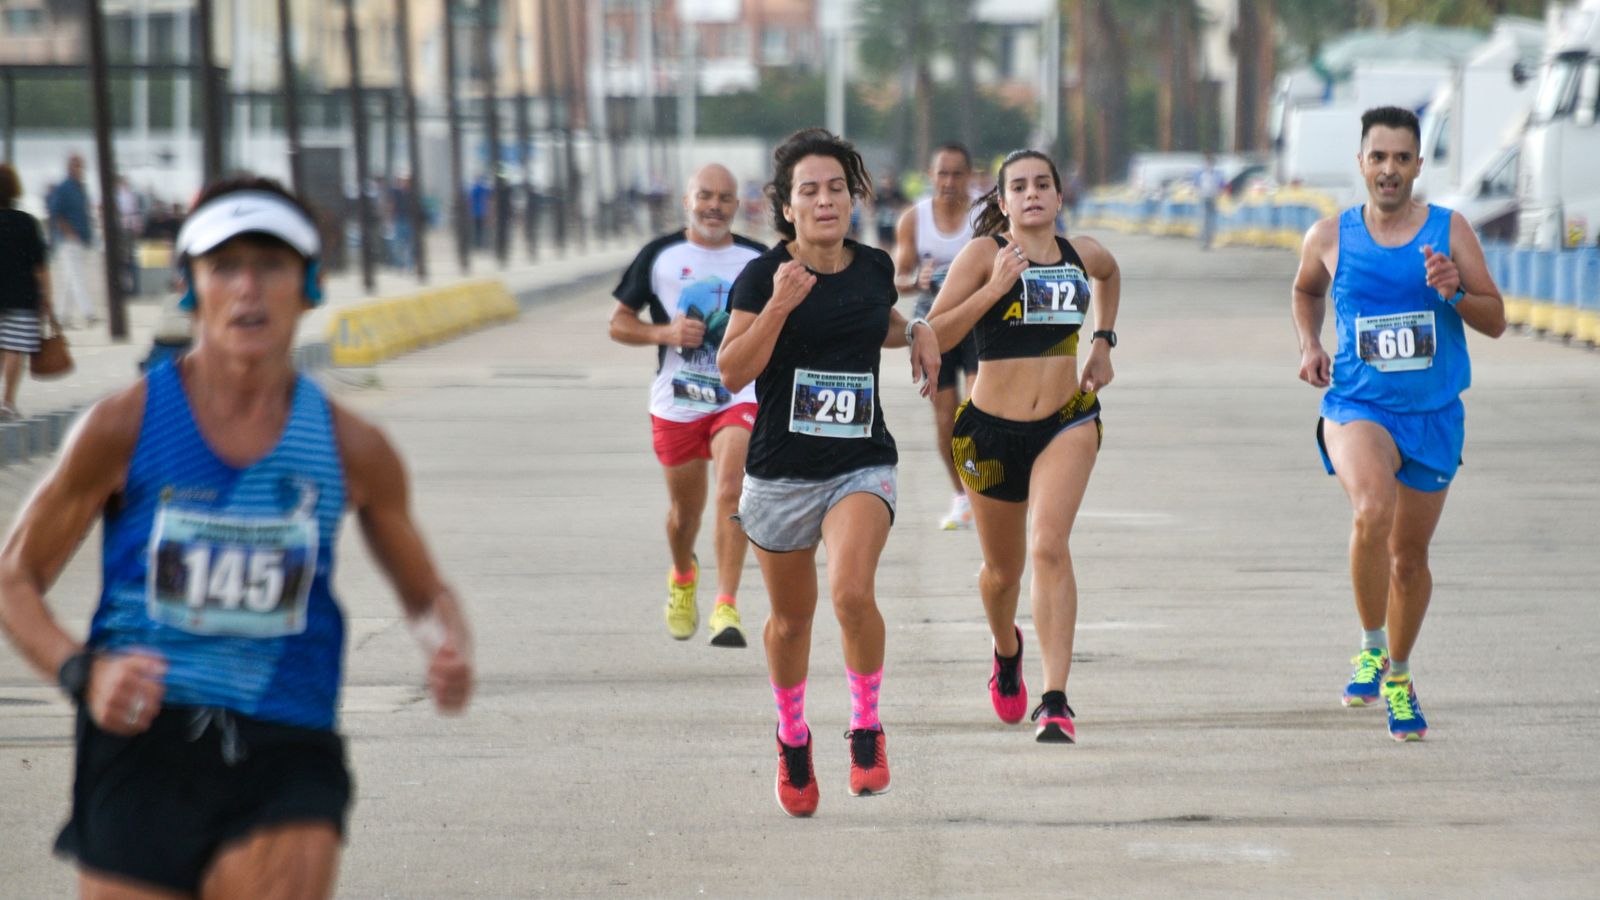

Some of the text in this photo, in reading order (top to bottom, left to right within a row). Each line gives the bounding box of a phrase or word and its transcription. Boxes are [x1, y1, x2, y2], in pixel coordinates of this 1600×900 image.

[1045, 281, 1078, 311] 72
[1378, 327, 1416, 360] 60
[686, 383, 717, 404] 99
[815, 389, 856, 424] 29
[184, 549, 286, 613] 145
